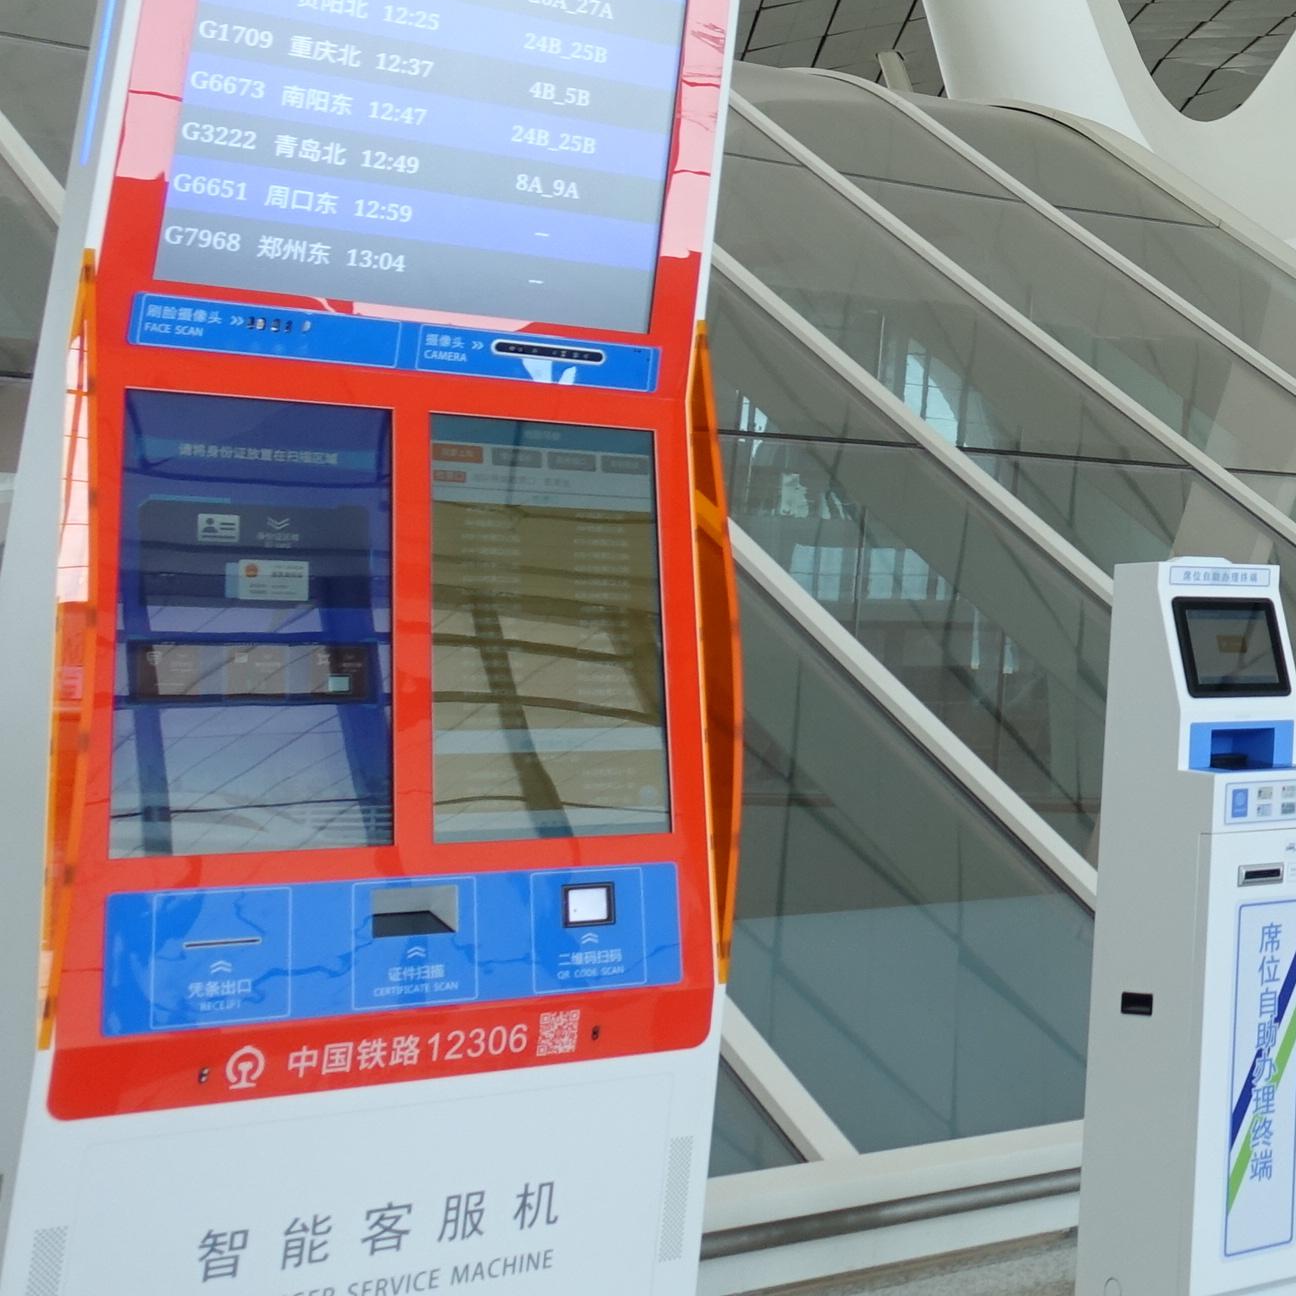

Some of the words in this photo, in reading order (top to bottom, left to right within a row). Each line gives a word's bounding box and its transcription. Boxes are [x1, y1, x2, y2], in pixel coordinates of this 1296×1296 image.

[382, 5, 441, 31] 12:25
[524, 33, 608, 64] 24B_25B
[198, 20, 273, 49] G1709
[288, 35, 361, 69] 重庆北
[375, 52, 435, 78] 12:37
[529, 81, 591, 107] 4B_5B
[190, 71, 266, 99] G6673
[281, 85, 353, 117] 南阳东
[367, 101, 428, 126] 12:47
[511, 125, 596, 154] 24B_25B
[182, 121, 257, 150] G3222
[273, 135, 347, 167] 青岛北
[360, 149, 420, 175] 12:49
[515, 174, 580, 200] 8A_9A
[173, 173, 248, 201] G6651
[264, 185, 339, 215] 周口东
[353, 199, 413, 223] 12:59
[164, 225, 241, 253] G7968
[256, 234, 332, 266] 郑州东
[346, 249, 406, 273] 13:04
[144, 322, 171, 335] FACE
[175, 325, 204, 337] SCAN
[424, 350, 467, 363] CAMERA
[188, 978, 252, 999] 凭条出口
[373, 984, 429, 997] CERTIFICATE
[432, 982, 458, 993] SCAN
[575, 968, 598, 978] CODE
[601, 966, 624, 976] SCAN
[287, 1024, 529, 1078] 中国铁路12306
[1249, 921, 1283, 1183] 席位自助办理终端
[197, 1179, 560, 1283] 智能客服机
[346, 1267, 442, 1296] SERVICE
[450, 1248, 554, 1286] MACHINE
